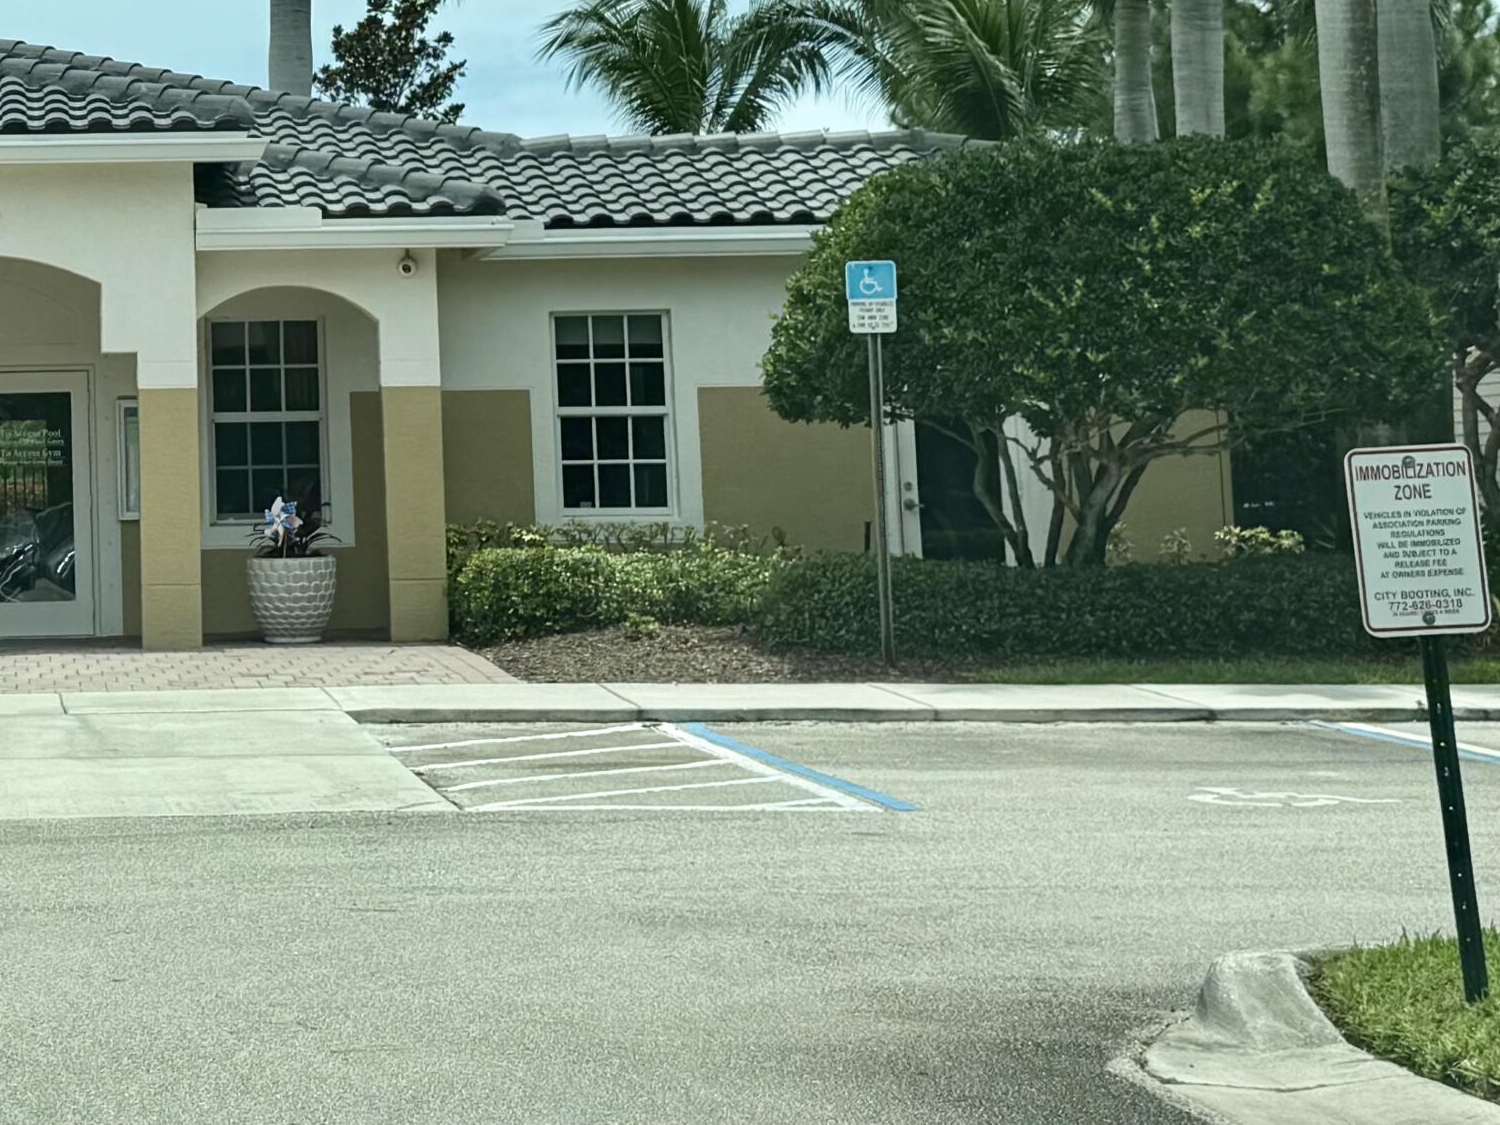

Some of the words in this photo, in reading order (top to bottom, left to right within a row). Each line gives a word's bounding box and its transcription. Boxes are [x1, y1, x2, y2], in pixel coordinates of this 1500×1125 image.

[1355, 461, 1466, 481] IMMOBILIZATION
[1394, 483, 1432, 501] ZONE
[1363, 510, 1402, 520] VEHICLES
[1403, 510, 1412, 518] IN
[1412, 508, 1455, 518] VIOLATION
[1455, 507, 1467, 516] OF
[1372, 520, 1425, 530] ASSOCIATION
[1426, 518, 1462, 527] PARKING
[1390, 528, 1446, 539] REGULATIONS
[1376, 541, 1396, 550] WILL
[1397, 540, 1409, 549] BE
[1410, 538, 1461, 548] IMMOBILIZED
[1383, 551, 1400, 559] AND
[1402, 549, 1437, 559] SUBJECT
[1439, 548, 1450, 557] TO
[1451, 548, 1458, 556] A
[1394, 559, 1431, 569] RELEASE
[1432, 558, 1448, 567] FEE
[1380, 571, 1390, 579] AT
[1427, 567, 1465, 577] EXPENSE
[1374, 590, 1397, 601] CITY
[1400, 588, 1451, 600] BOOTING,
[1453, 587, 1475, 597] INC.
[1388, 598, 1463, 612] 772-626-0318
